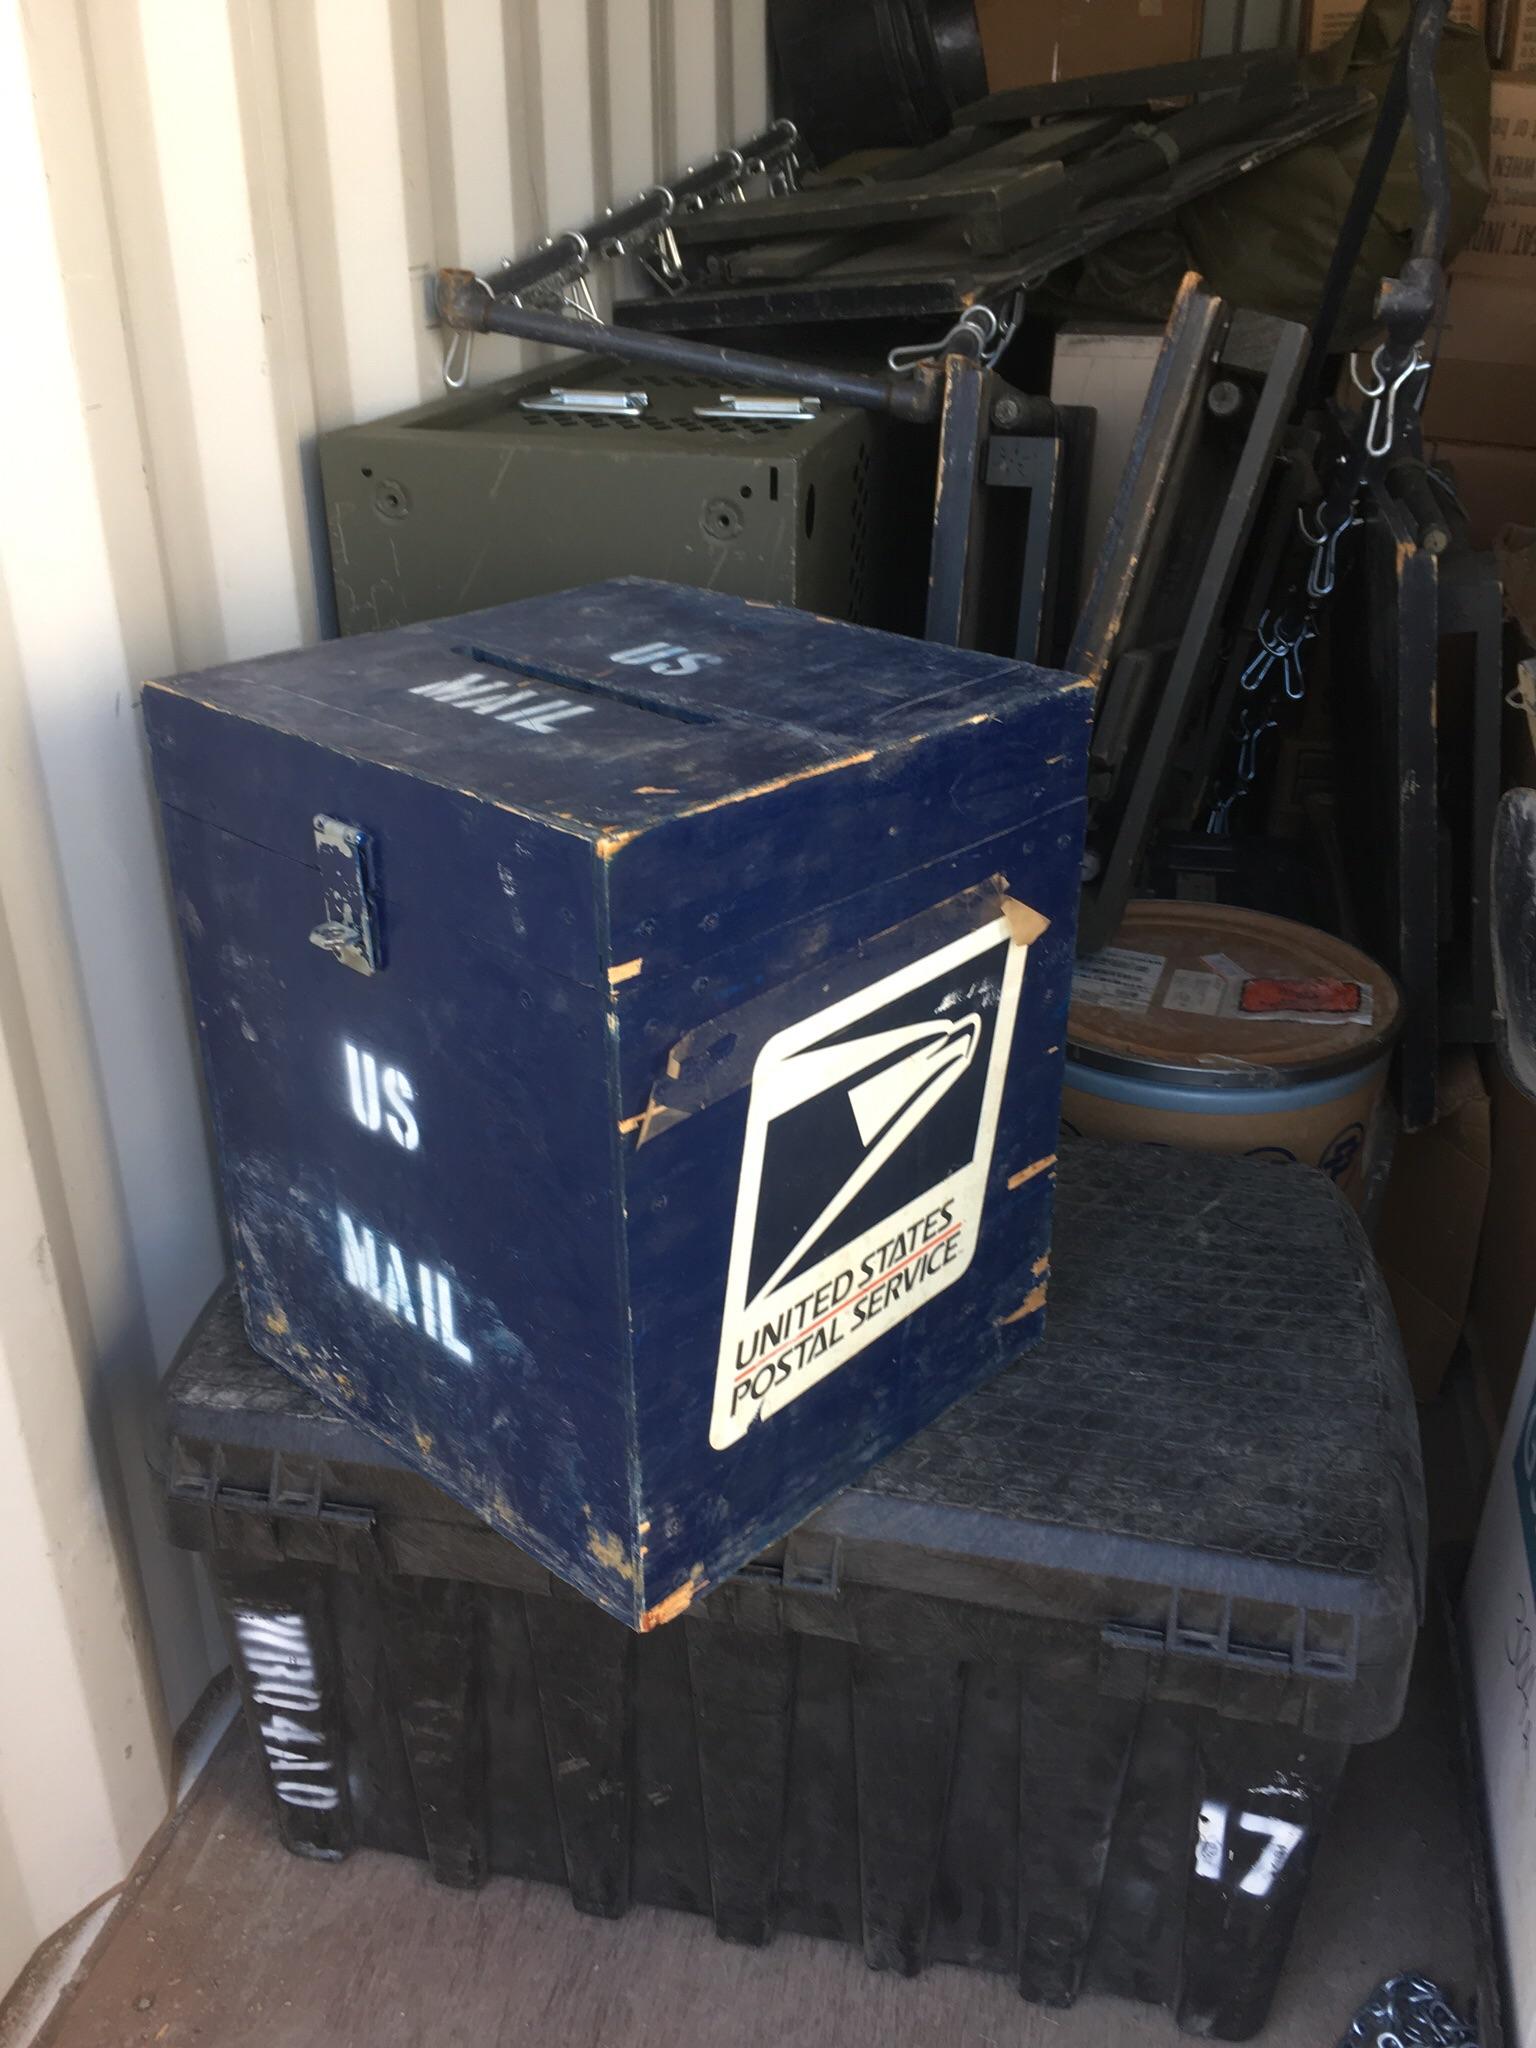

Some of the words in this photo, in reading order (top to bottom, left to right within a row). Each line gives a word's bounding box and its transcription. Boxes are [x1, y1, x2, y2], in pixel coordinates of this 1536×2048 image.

[408, 674, 595, 734] MAIL
[610, 642, 723, 676] US
[345, 1043, 420, 1150] US
[338, 1210, 473, 1363] MAIL
[730, 1317, 844, 1418] POSTAL
[851, 1231, 961, 1332] SERVICE
[735, 1269, 854, 1371] UNITED
[858, 1197, 955, 1288] STATES
[1195, 1801, 1303, 1896] 17
